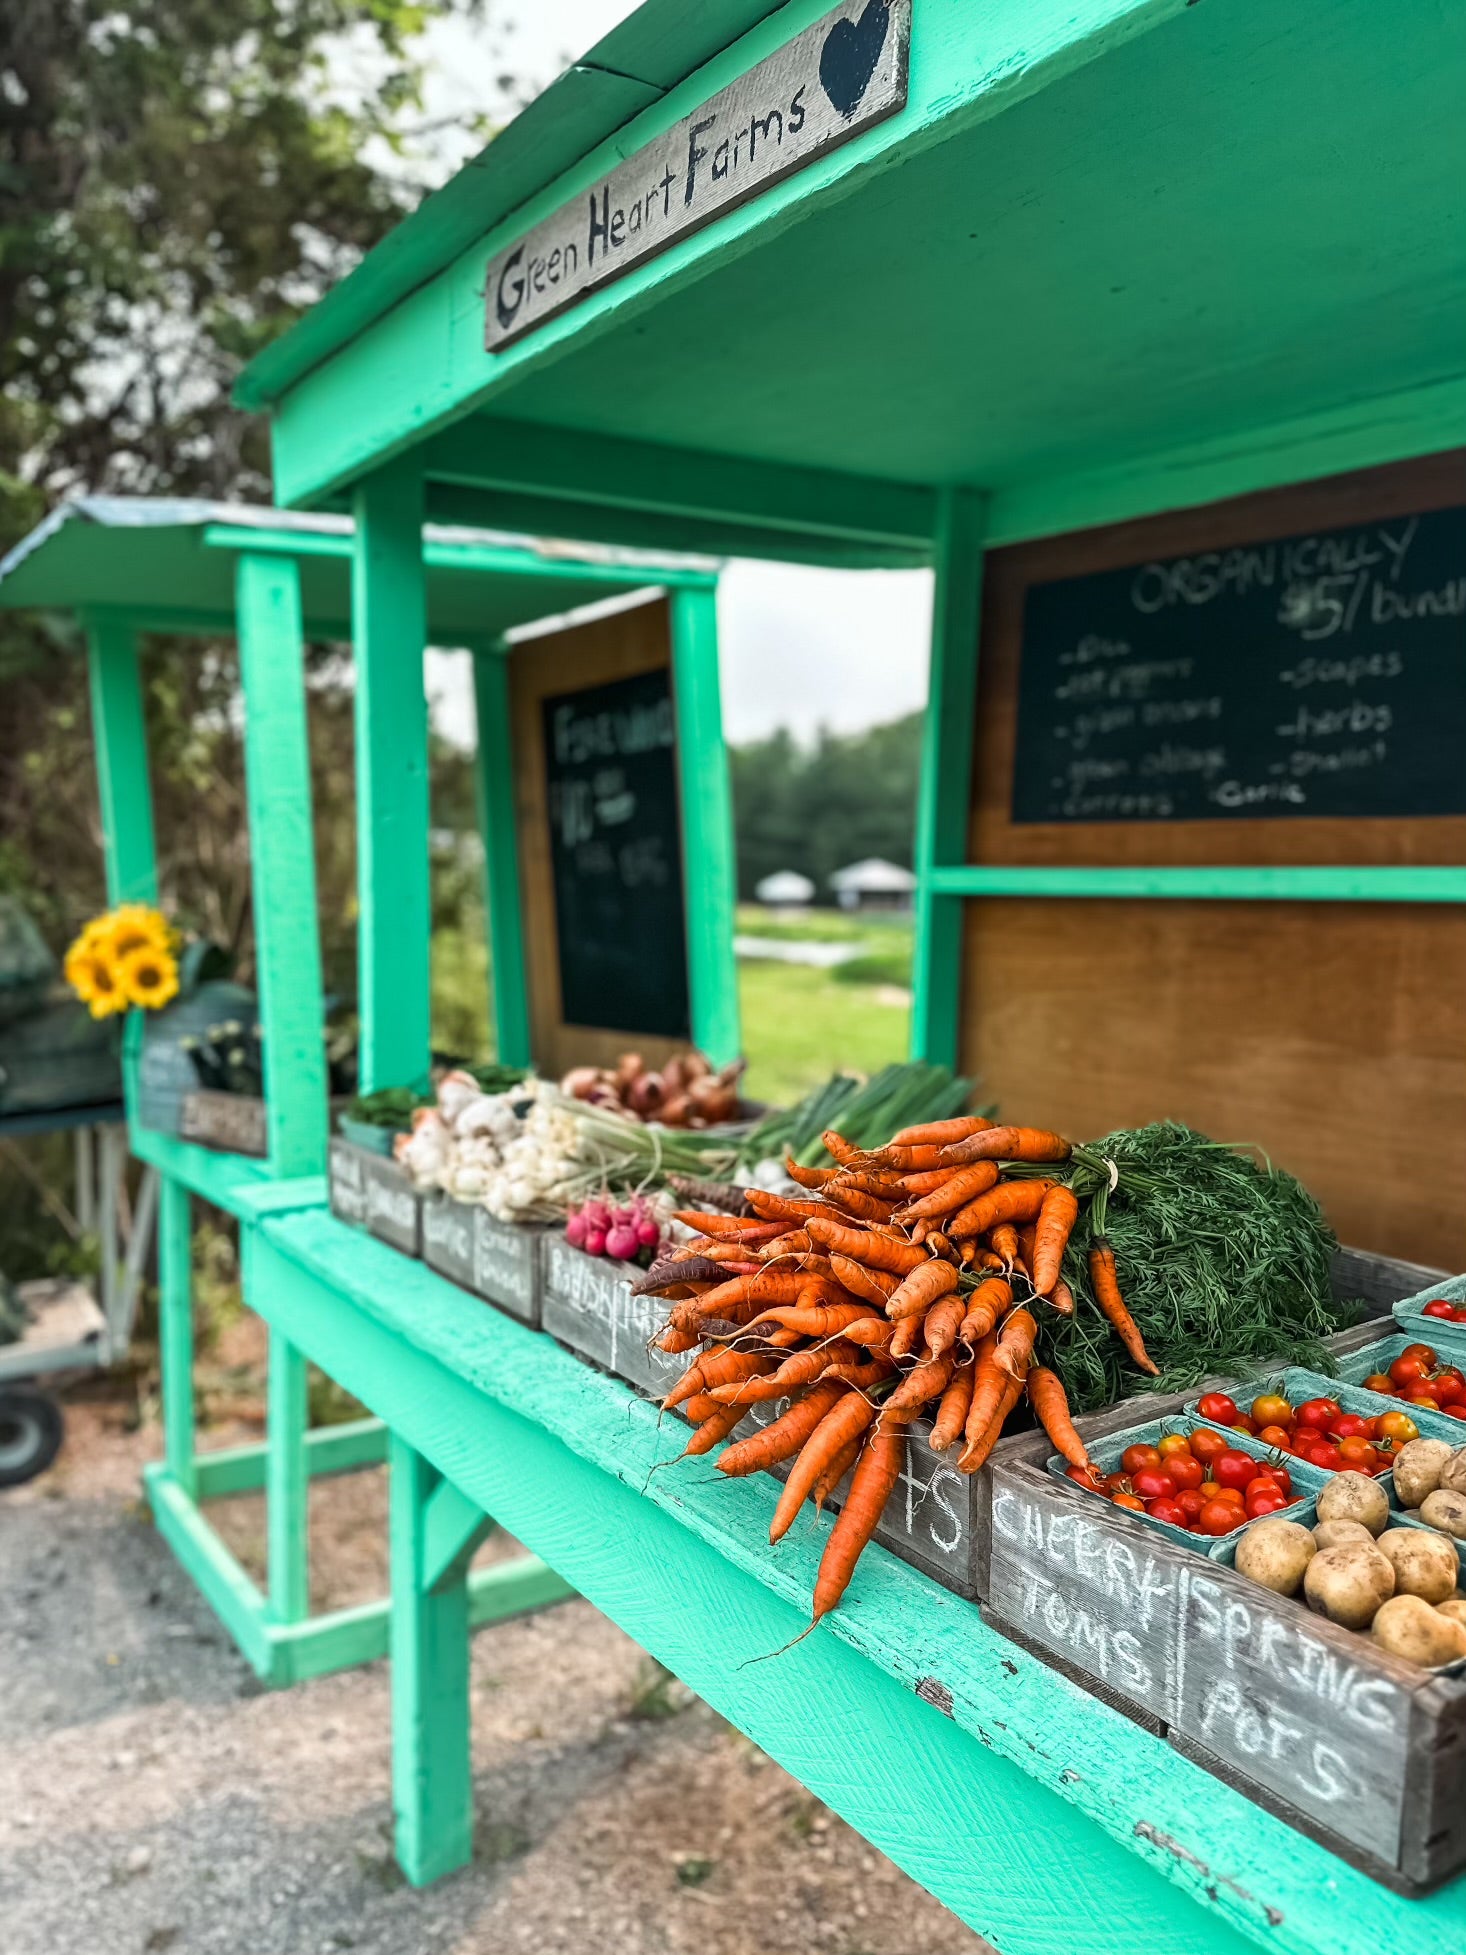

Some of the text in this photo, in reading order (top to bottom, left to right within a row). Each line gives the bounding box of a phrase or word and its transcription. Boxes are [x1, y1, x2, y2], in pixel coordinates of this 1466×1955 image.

[496, 84, 807, 330] Green Heart Farms
[1131, 516, 1420, 613] ORGANICALLY
[992, 1488, 1174, 1632] CHERRY
[1020, 1566, 1153, 1695] TOMS
[1189, 1578, 1399, 1731] SPRING
[1199, 1679, 1352, 1801] POTS
